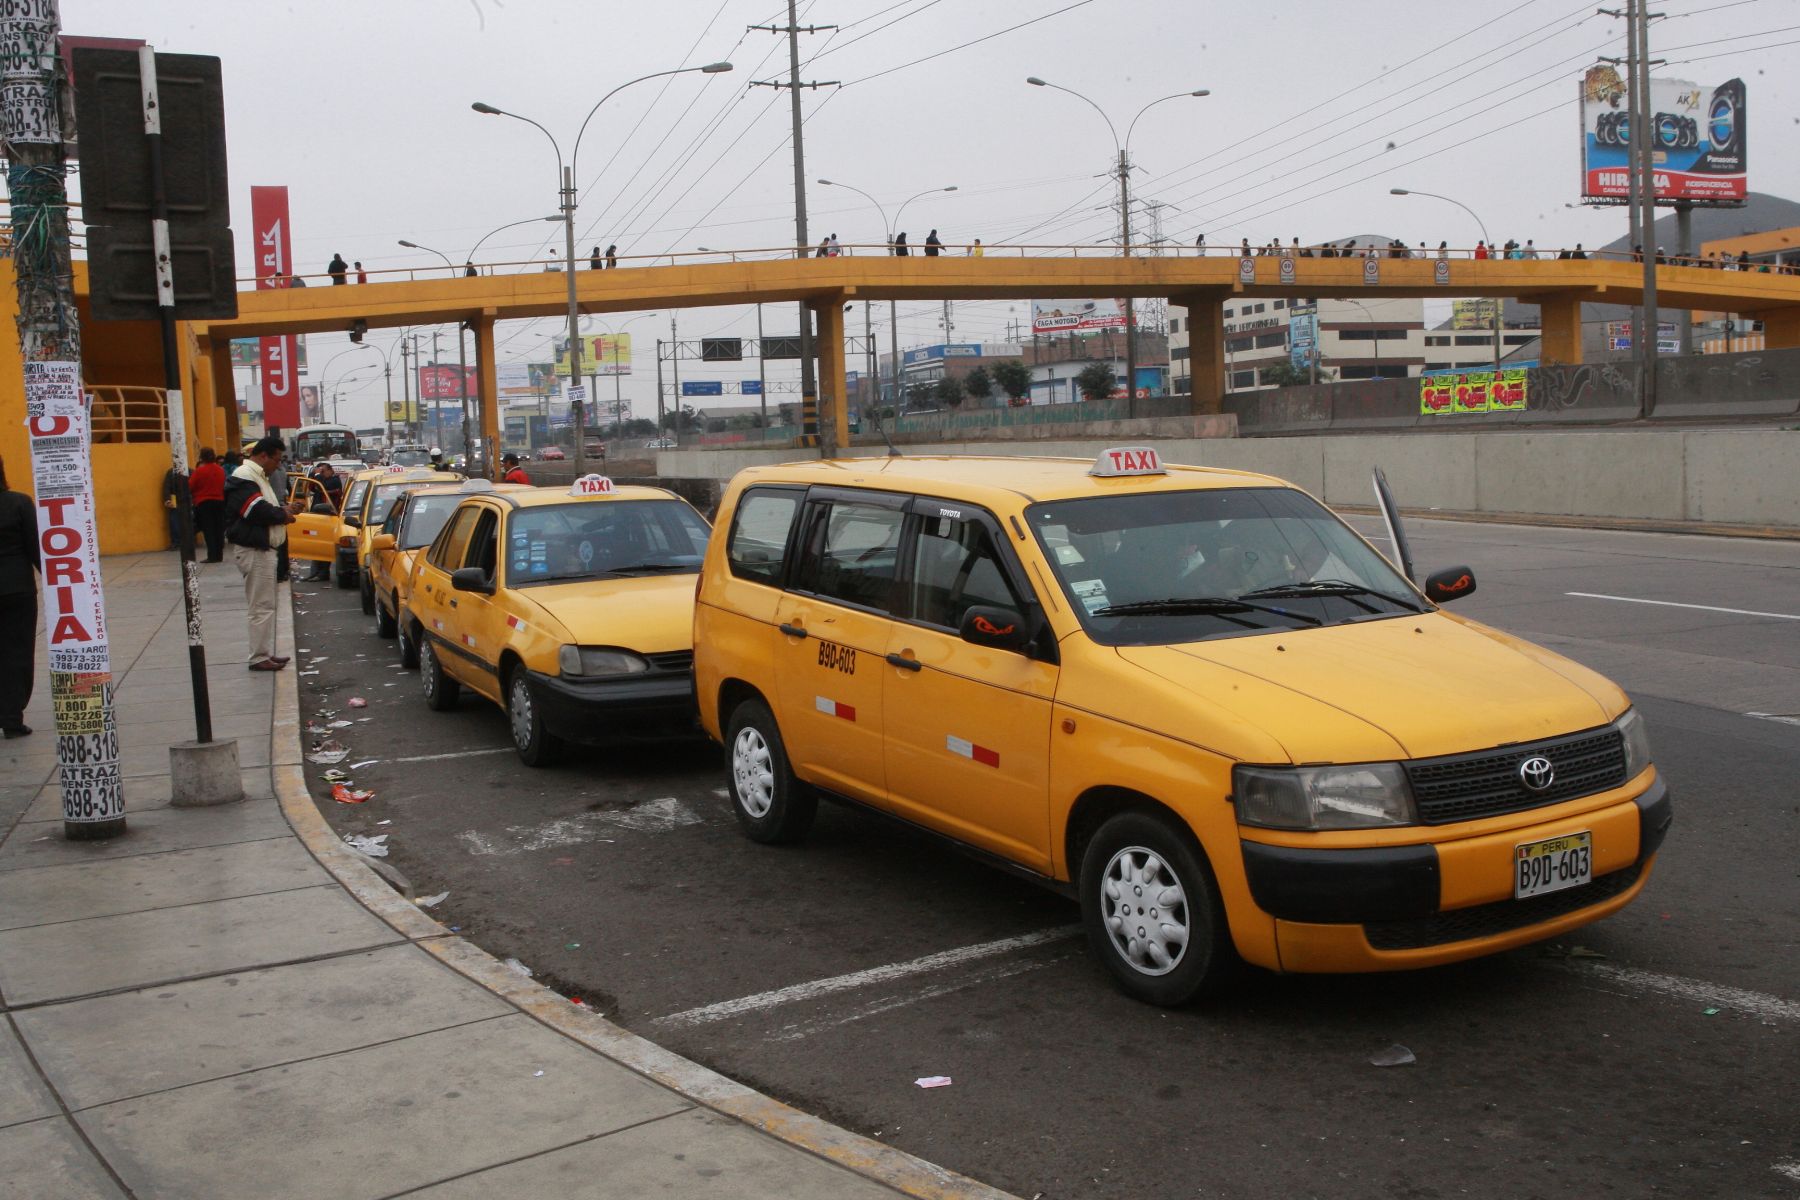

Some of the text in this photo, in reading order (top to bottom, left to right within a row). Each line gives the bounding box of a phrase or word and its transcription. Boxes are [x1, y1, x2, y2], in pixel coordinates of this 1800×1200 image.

[1707, 155, 1739, 164] Panasonic
[1037, 319, 1054, 328] FAGA
[1054, 317, 1079, 326] MOTORS
[1109, 450, 1158, 472] TAXI
[580, 479, 611, 493] TAXI
[940, 508, 961, 519] TOYOTA
[94, 601, 105, 641] CENTRO
[818, 641, 856, 676] B9D-603
[56, 662, 102, 671] 786-8022
[65, 700, 88, 712] 800
[60, 733, 119, 764] 698-318
[66, 785, 126, 817] 698-318
[1542, 840, 1569, 854] PERU
[1520, 846, 1589, 890] B9D-603
